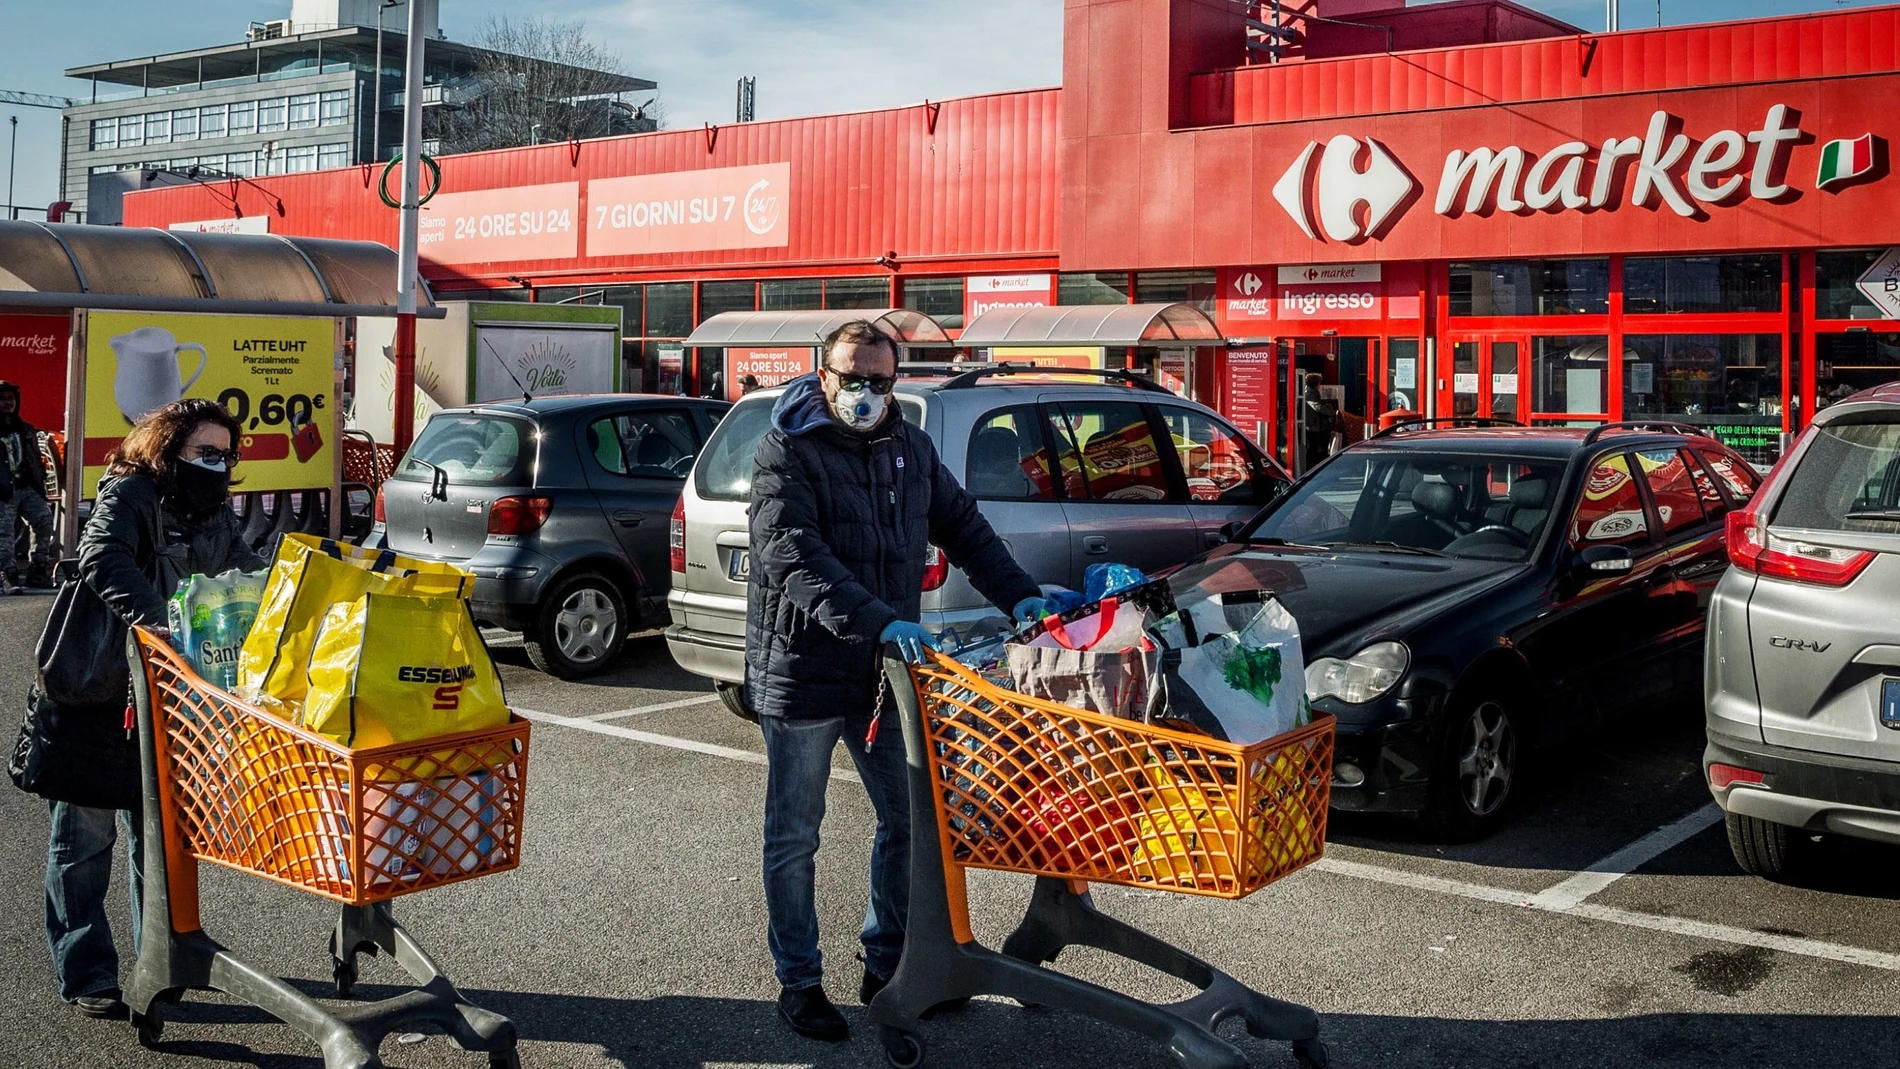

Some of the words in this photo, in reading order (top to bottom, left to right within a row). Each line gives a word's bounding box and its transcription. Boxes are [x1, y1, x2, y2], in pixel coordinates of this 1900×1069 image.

[1434, 103, 1800, 217] market
[596, 206, 608, 229] 7
[611, 200, 685, 229] GIORNI
[689, 197, 718, 224] SU
[722, 196, 736, 222] 7
[420, 216, 445, 228] Siamo
[454, 216, 476, 240] 24
[479, 213, 516, 237] ORE
[519, 211, 544, 235] SU
[546, 209, 571, 233] 24
[419, 230, 445, 245] aperti
[1321, 267, 1356, 279] market
[1002, 278, 1029, 286] market
[1229, 298, 1268, 311] market
[1284, 291, 1375, 315] Ingresso
[1, 334, 56, 349] market
[233, 340, 277, 351] LATTE
[279, 341, 307, 351] UHT
[243, 356, 299, 364] Parzialmente
[769, 352, 787, 360] aperti
[251, 366, 293, 375] Scremato
[736, 361, 749, 373] 24
[751, 361, 772, 373] ORE
[773, 361, 787, 372] SU
[788, 361, 802, 372] 24
[526, 364, 568, 392] Voilà
[1740, 438, 1767, 446] CROISSANT
[1769, 636, 1831, 652] CR-V
